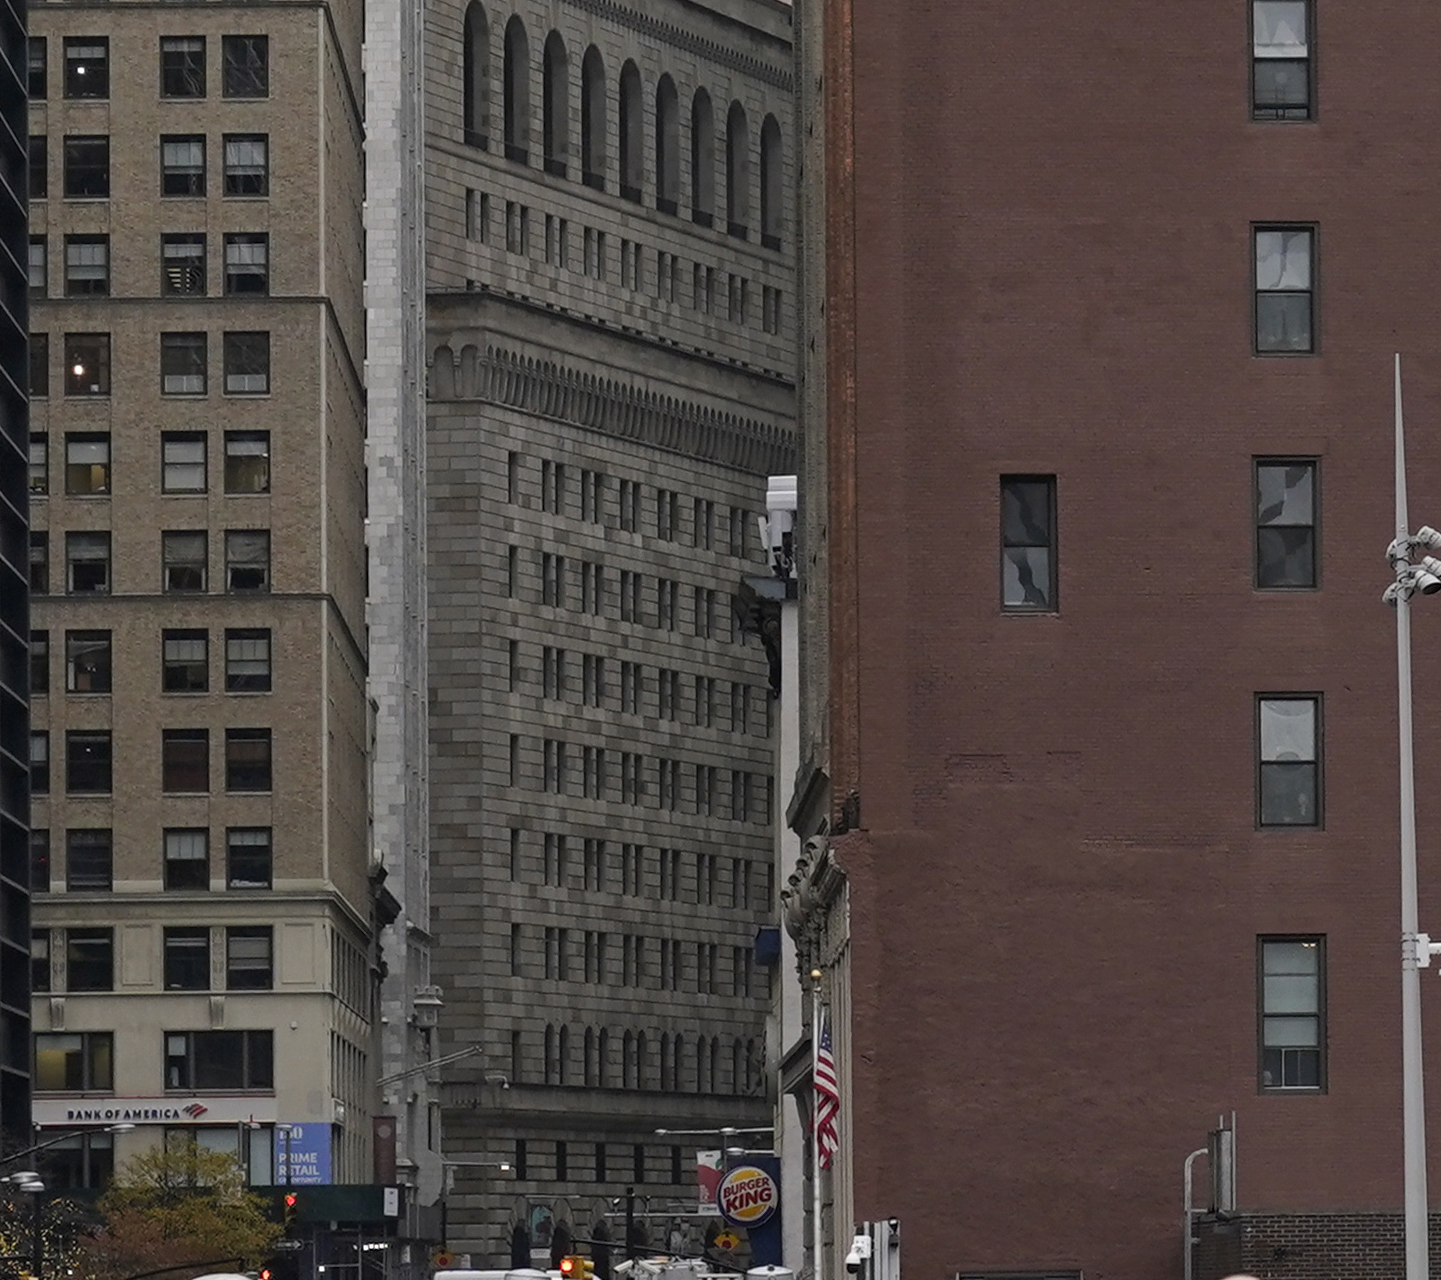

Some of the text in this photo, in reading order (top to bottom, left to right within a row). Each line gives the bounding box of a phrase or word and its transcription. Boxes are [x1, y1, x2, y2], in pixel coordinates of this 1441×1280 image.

[67, 1109, 180, 1120] BANK OF AMERICA
[723, 1176, 770, 1199] BURGER
[725, 1187, 773, 1214] KING
